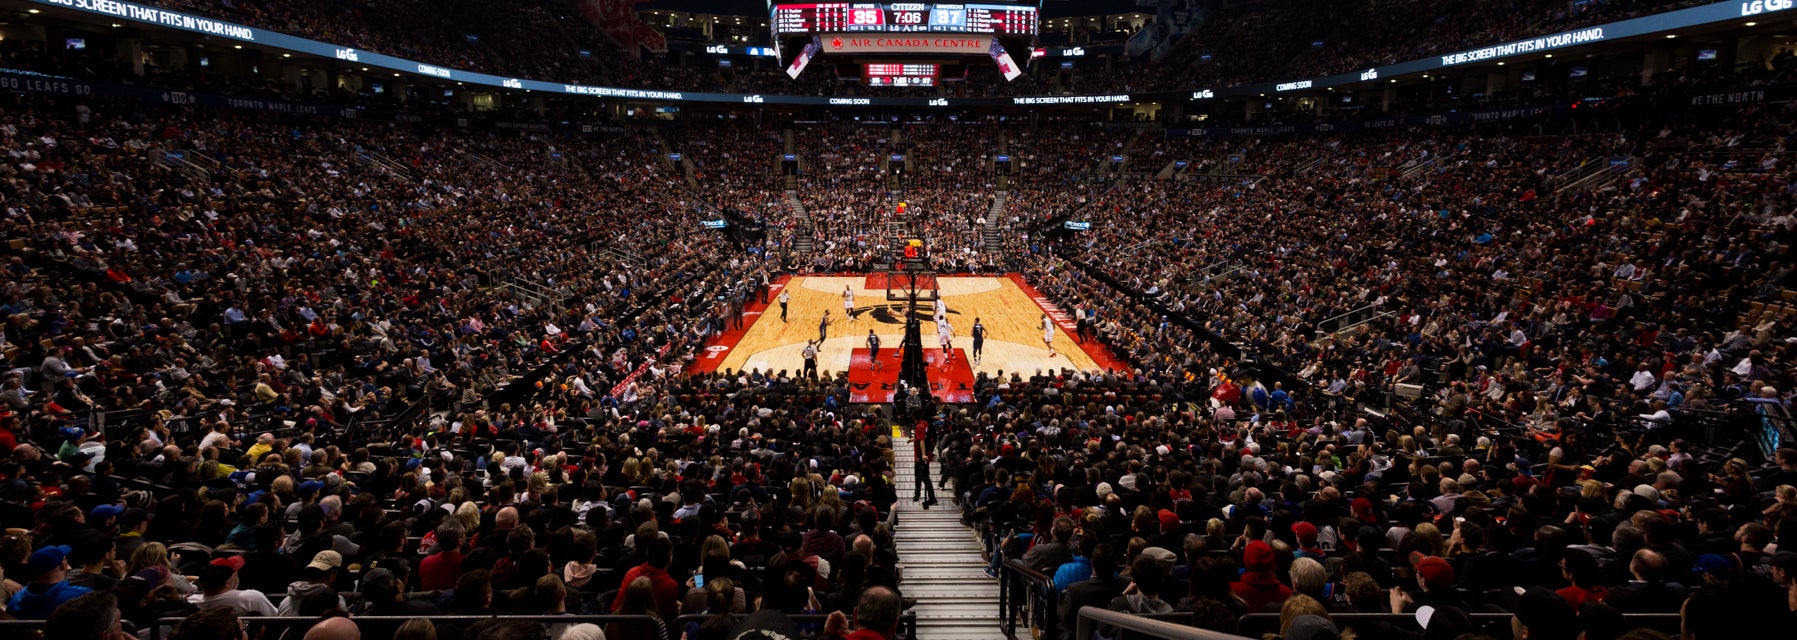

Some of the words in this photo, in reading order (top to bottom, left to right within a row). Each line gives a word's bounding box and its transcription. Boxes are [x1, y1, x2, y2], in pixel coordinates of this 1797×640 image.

[1741, 0, 1762, 16] LG
[1764, 0, 1792, 11] G6
[75, 0, 127, 16] SCREEN
[127, 5, 158, 22] THAT
[160, 11, 182, 26] FITS
[182, 16, 195, 29] IN
[196, 19, 224, 34] YOUR
[224, 24, 254, 40] HAND.
[854, 10, 877, 24] 35
[894, 12, 921, 23] 7:06
[938, 10, 962, 24] 37
[877, 38, 929, 47] CANADA
[934, 39, 981, 48] CENTRE
[1442, 55, 1455, 66] THE
[1456, 53, 1467, 64] BIG
[1468, 48, 1496, 61] SCREEN
[1496, 44, 1517, 56] THAT
[1518, 41, 1534, 52] FITS
[1535, 39, 1545, 50] IN
[1546, 34, 1572, 47] YOUR
[1573, 28, 1604, 43] HAND.
[336, 49, 346, 60] LG
[418, 64, 438, 75] COMING
[438, 68, 450, 78] SOON
[27, 80, 68, 93] LEAFS
[588, 87, 611, 95] SCREEN
[1276, 82, 1297, 90] COMING
[1297, 80, 1312, 88] SOON
[1728, 90, 1764, 102] NORTH
